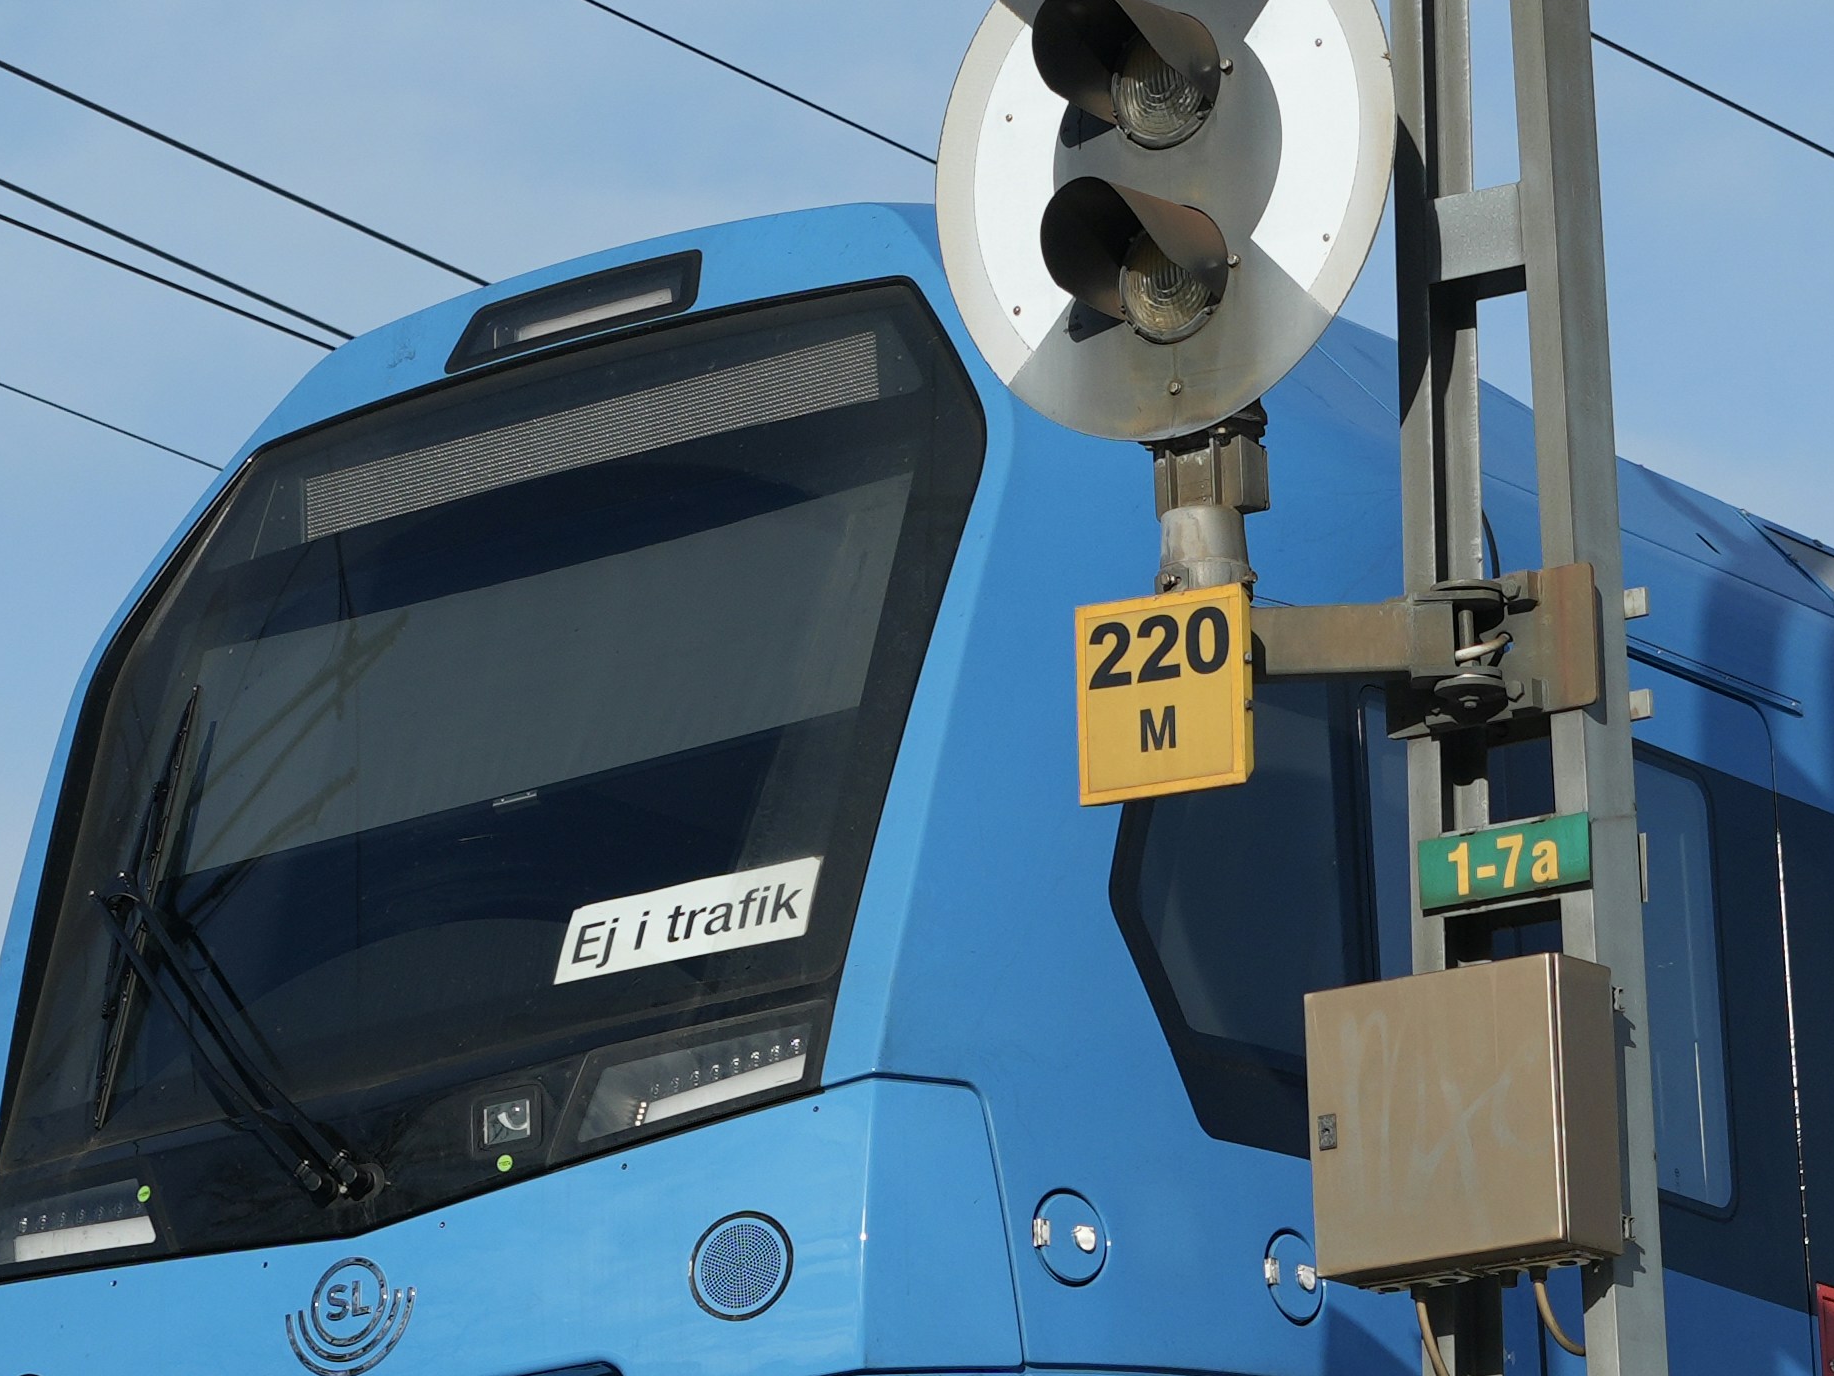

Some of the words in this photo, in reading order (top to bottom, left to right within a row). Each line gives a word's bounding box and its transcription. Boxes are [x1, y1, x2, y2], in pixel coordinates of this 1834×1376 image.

[1089, 606, 1229, 690] 220
[1139, 705, 1177, 753] M
[1447, 834, 1560, 896] 1-7a
[571, 917, 619, 969] Ej
[633, 910, 650, 951] i
[666, 882, 803, 943] trafik
[325, 1279, 373, 1321] SL
